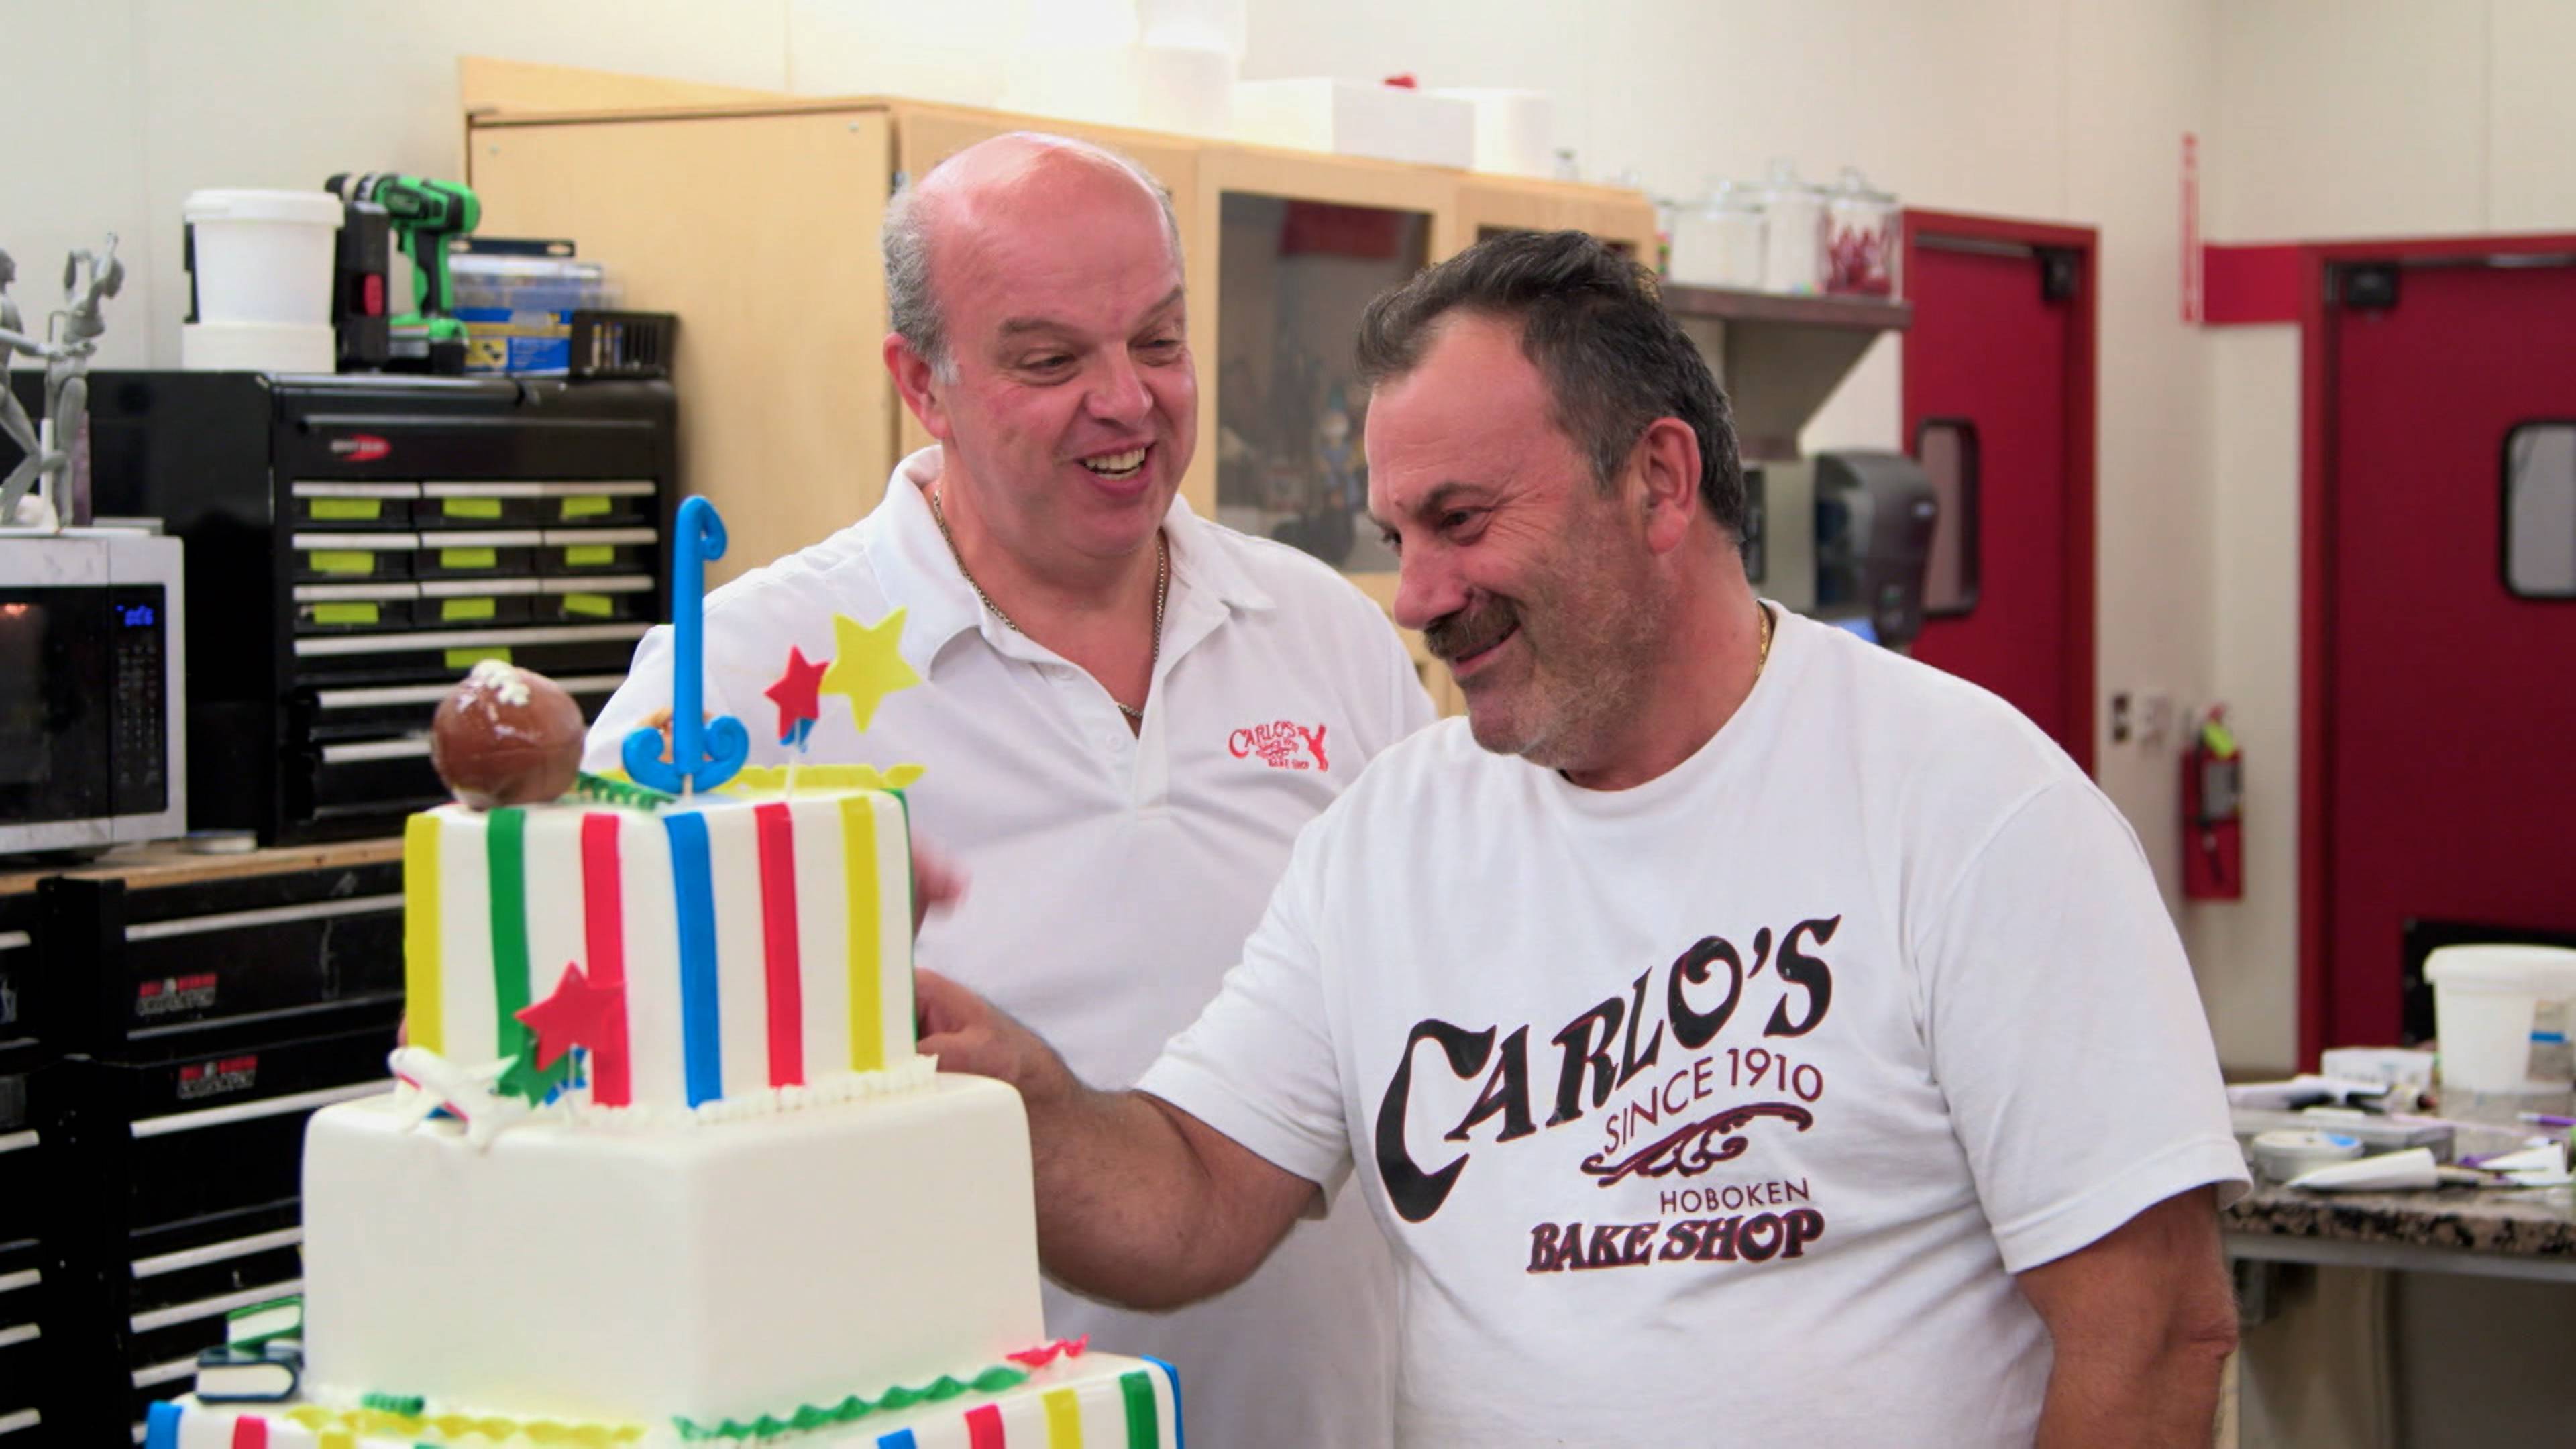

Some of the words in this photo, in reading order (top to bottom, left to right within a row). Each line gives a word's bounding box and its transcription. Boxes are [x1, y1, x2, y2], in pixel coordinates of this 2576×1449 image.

[1375, 914, 1842, 1223] CARLO'S
[1604, 1057, 1713, 1155] SINCE
[1727, 1048, 1823, 1102] 1910
[1661, 1178, 1810, 1214] HOBOKEN
[1527, 1222, 1661, 1274] BAKE
[1658, 1208, 1825, 1263] SHOP
